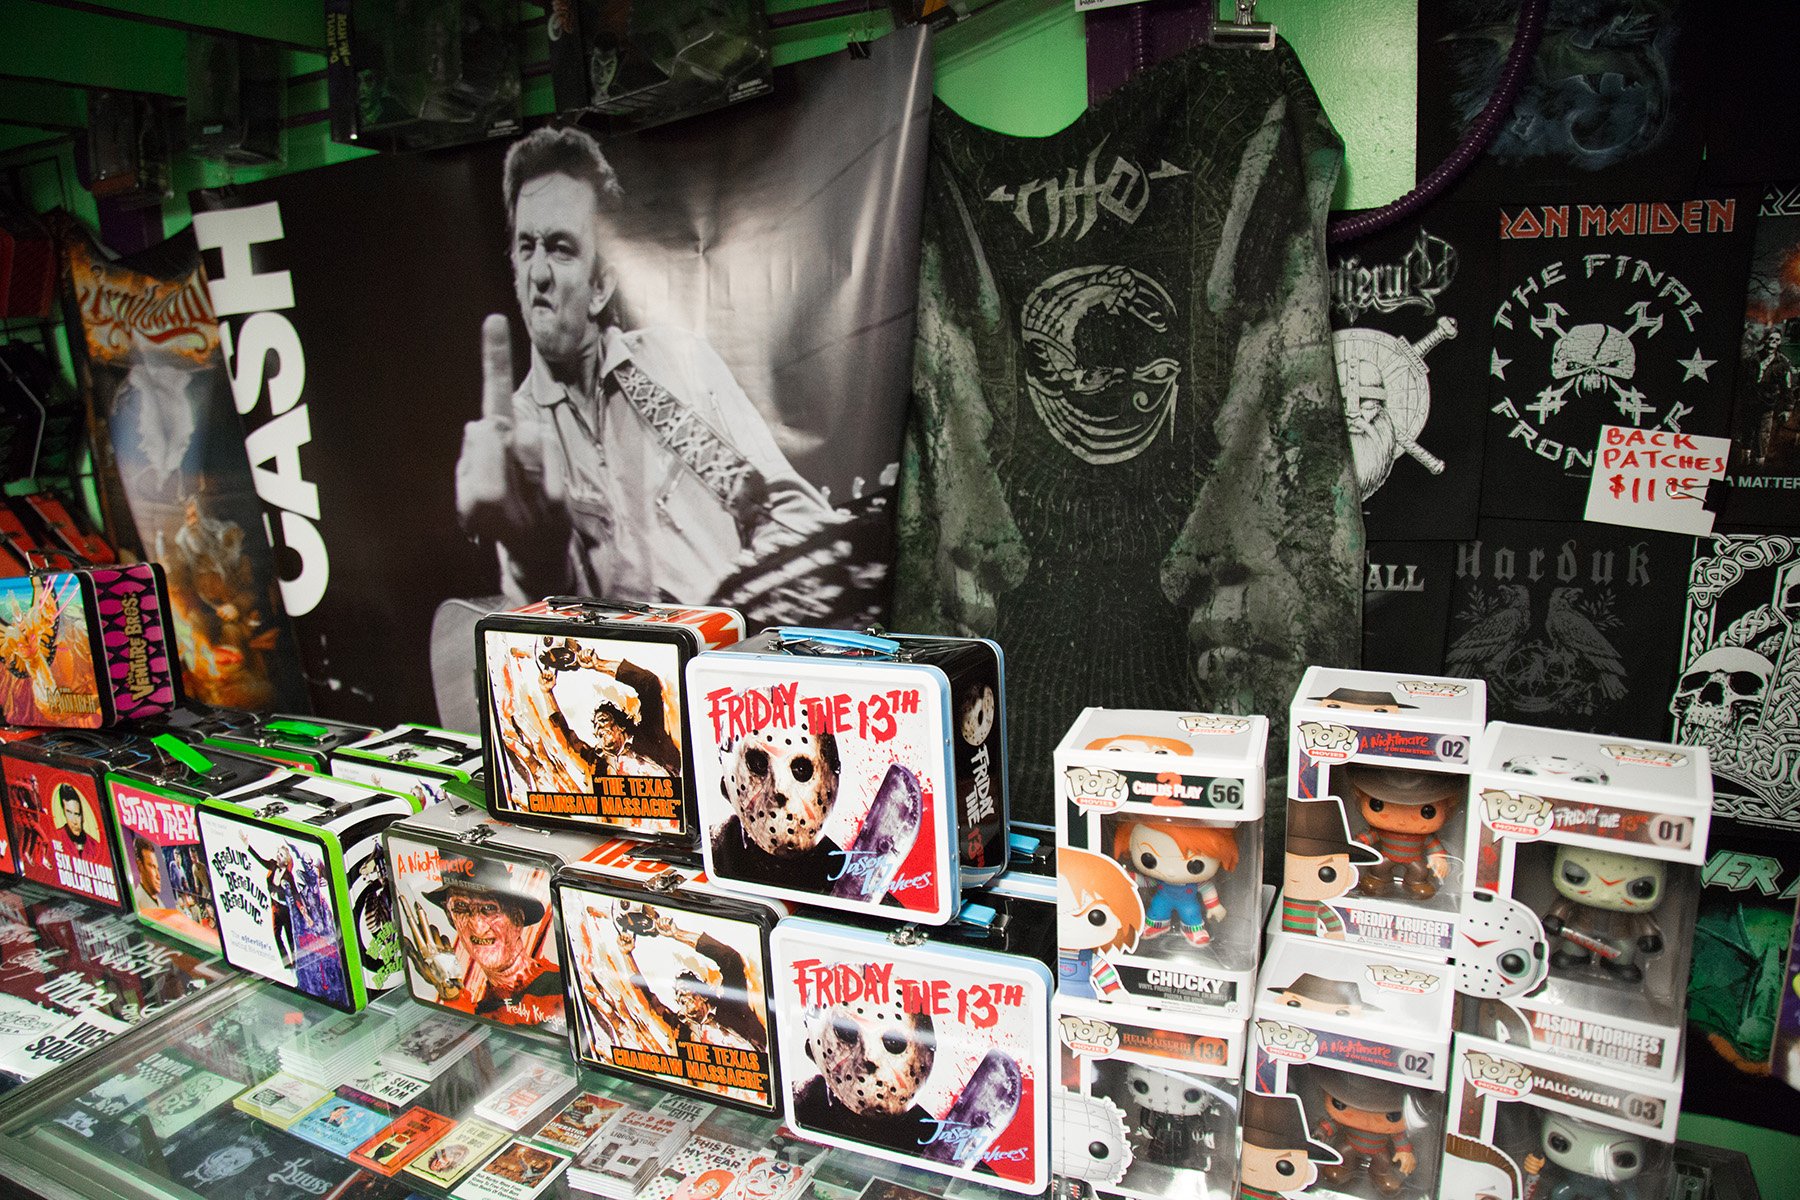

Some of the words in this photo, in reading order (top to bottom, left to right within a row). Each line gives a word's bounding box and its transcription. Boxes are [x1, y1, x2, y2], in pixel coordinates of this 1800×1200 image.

[1500, 205, 1569, 240] RON
[1577, 198, 1737, 237] MAIDEN
[1493, 261, 1567, 330] THE
[1582, 253, 1703, 333] FINAL
[192, 200, 330, 618] CASH
[1491, 396, 1694, 470] FRONR
[1606, 427, 1699, 450] BACK
[1602, 448, 1726, 473] PATCHES
[1738, 476, 1800, 490] MATTER
[129, 637, 155, 701] VENTURE
[704, 682, 799, 744] FRIDAY
[800, 693, 853, 736] THE
[858, 689, 922, 744] 13TH
[1297, 722, 1360, 751] POP!
[1371, 732, 1430, 752] Nightmare
[1441, 740, 1464, 759] 02
[1309, 749, 1347, 758] MOVIES
[628, 778, 673, 798] TEXAS
[969, 743, 996, 819] FRIDAY
[1064, 767, 1128, 799] POP!
[1174, 784, 1204, 800] PLAY
[1212, 785, 1241, 804] 56
[529, 794, 598, 814] CHAINSAW
[966, 784, 985, 829] THE
[1077, 797, 1116, 807] MOVIES
[1480, 790, 1554, 826] POP!
[118, 793, 158, 835] STAR
[155, 803, 200, 841] TREK
[1492, 822, 1538, 835] MOVIES
[1658, 821, 1685, 842] 01
[55, 852, 72, 870] SIX
[72, 857, 115, 885] MILLION
[397, 853, 406, 879] A
[407, 850, 475, 877] Nightmare
[58, 868, 94, 895] DOLLAR
[92, 880, 119, 902] MAN
[1350, 911, 1395, 929] FREDDY
[1396, 915, 1450, 937] KRUEGER
[1359, 925, 1394, 940] VINYL
[1399, 931, 1442, 946] FIGURE
[90, 948, 171, 980] NASTY
[1367, 965, 1440, 989] POP!
[790, 958, 894, 1009] FRIDAY
[894, 979, 952, 1016] THE
[957, 983, 1026, 1030] 13TH
[1146, 969, 1224, 994] CHUCKY
[504, 998, 531, 1022] Freddy
[64, 1021, 118, 1047] VICE
[1058, 1016, 1118, 1046] POP!
[1256, 1020, 1318, 1052] POP!
[1534, 1013, 1581, 1038] JASON
[1582, 1023, 1660, 1055] VOORHEES
[25, 1035, 85, 1063] SQUA
[712, 1047, 760, 1072] TEXAS
[1070, 1042, 1109, 1054] MOVIES
[1198, 1042, 1224, 1060] 134
[1544, 1030, 1589, 1052] VINYL
[1593, 1042, 1648, 1065] FIGURE
[613, 1048, 684, 1078] CHAINSAW
[1405, 1055, 1428, 1073] 02
[1463, 1052, 1532, 1088] POP!
[379, 1085, 410, 1101] MOM
[390, 1077, 422, 1093] SURE
[1474, 1080, 1518, 1096] MOVIES
[678, 1101, 703, 1115] HATE
[1534, 1076, 1620, 1110] HALLOWEEN
[1628, 1099, 1658, 1121] 03
[668, 1107, 699, 1123] GUTS
[683, 1147, 701, 1158] MY
[704, 1153, 741, 1169] YEAR
[693, 1137, 722, 1153] THIS
[267, 1157, 333, 1195] Kyuss
